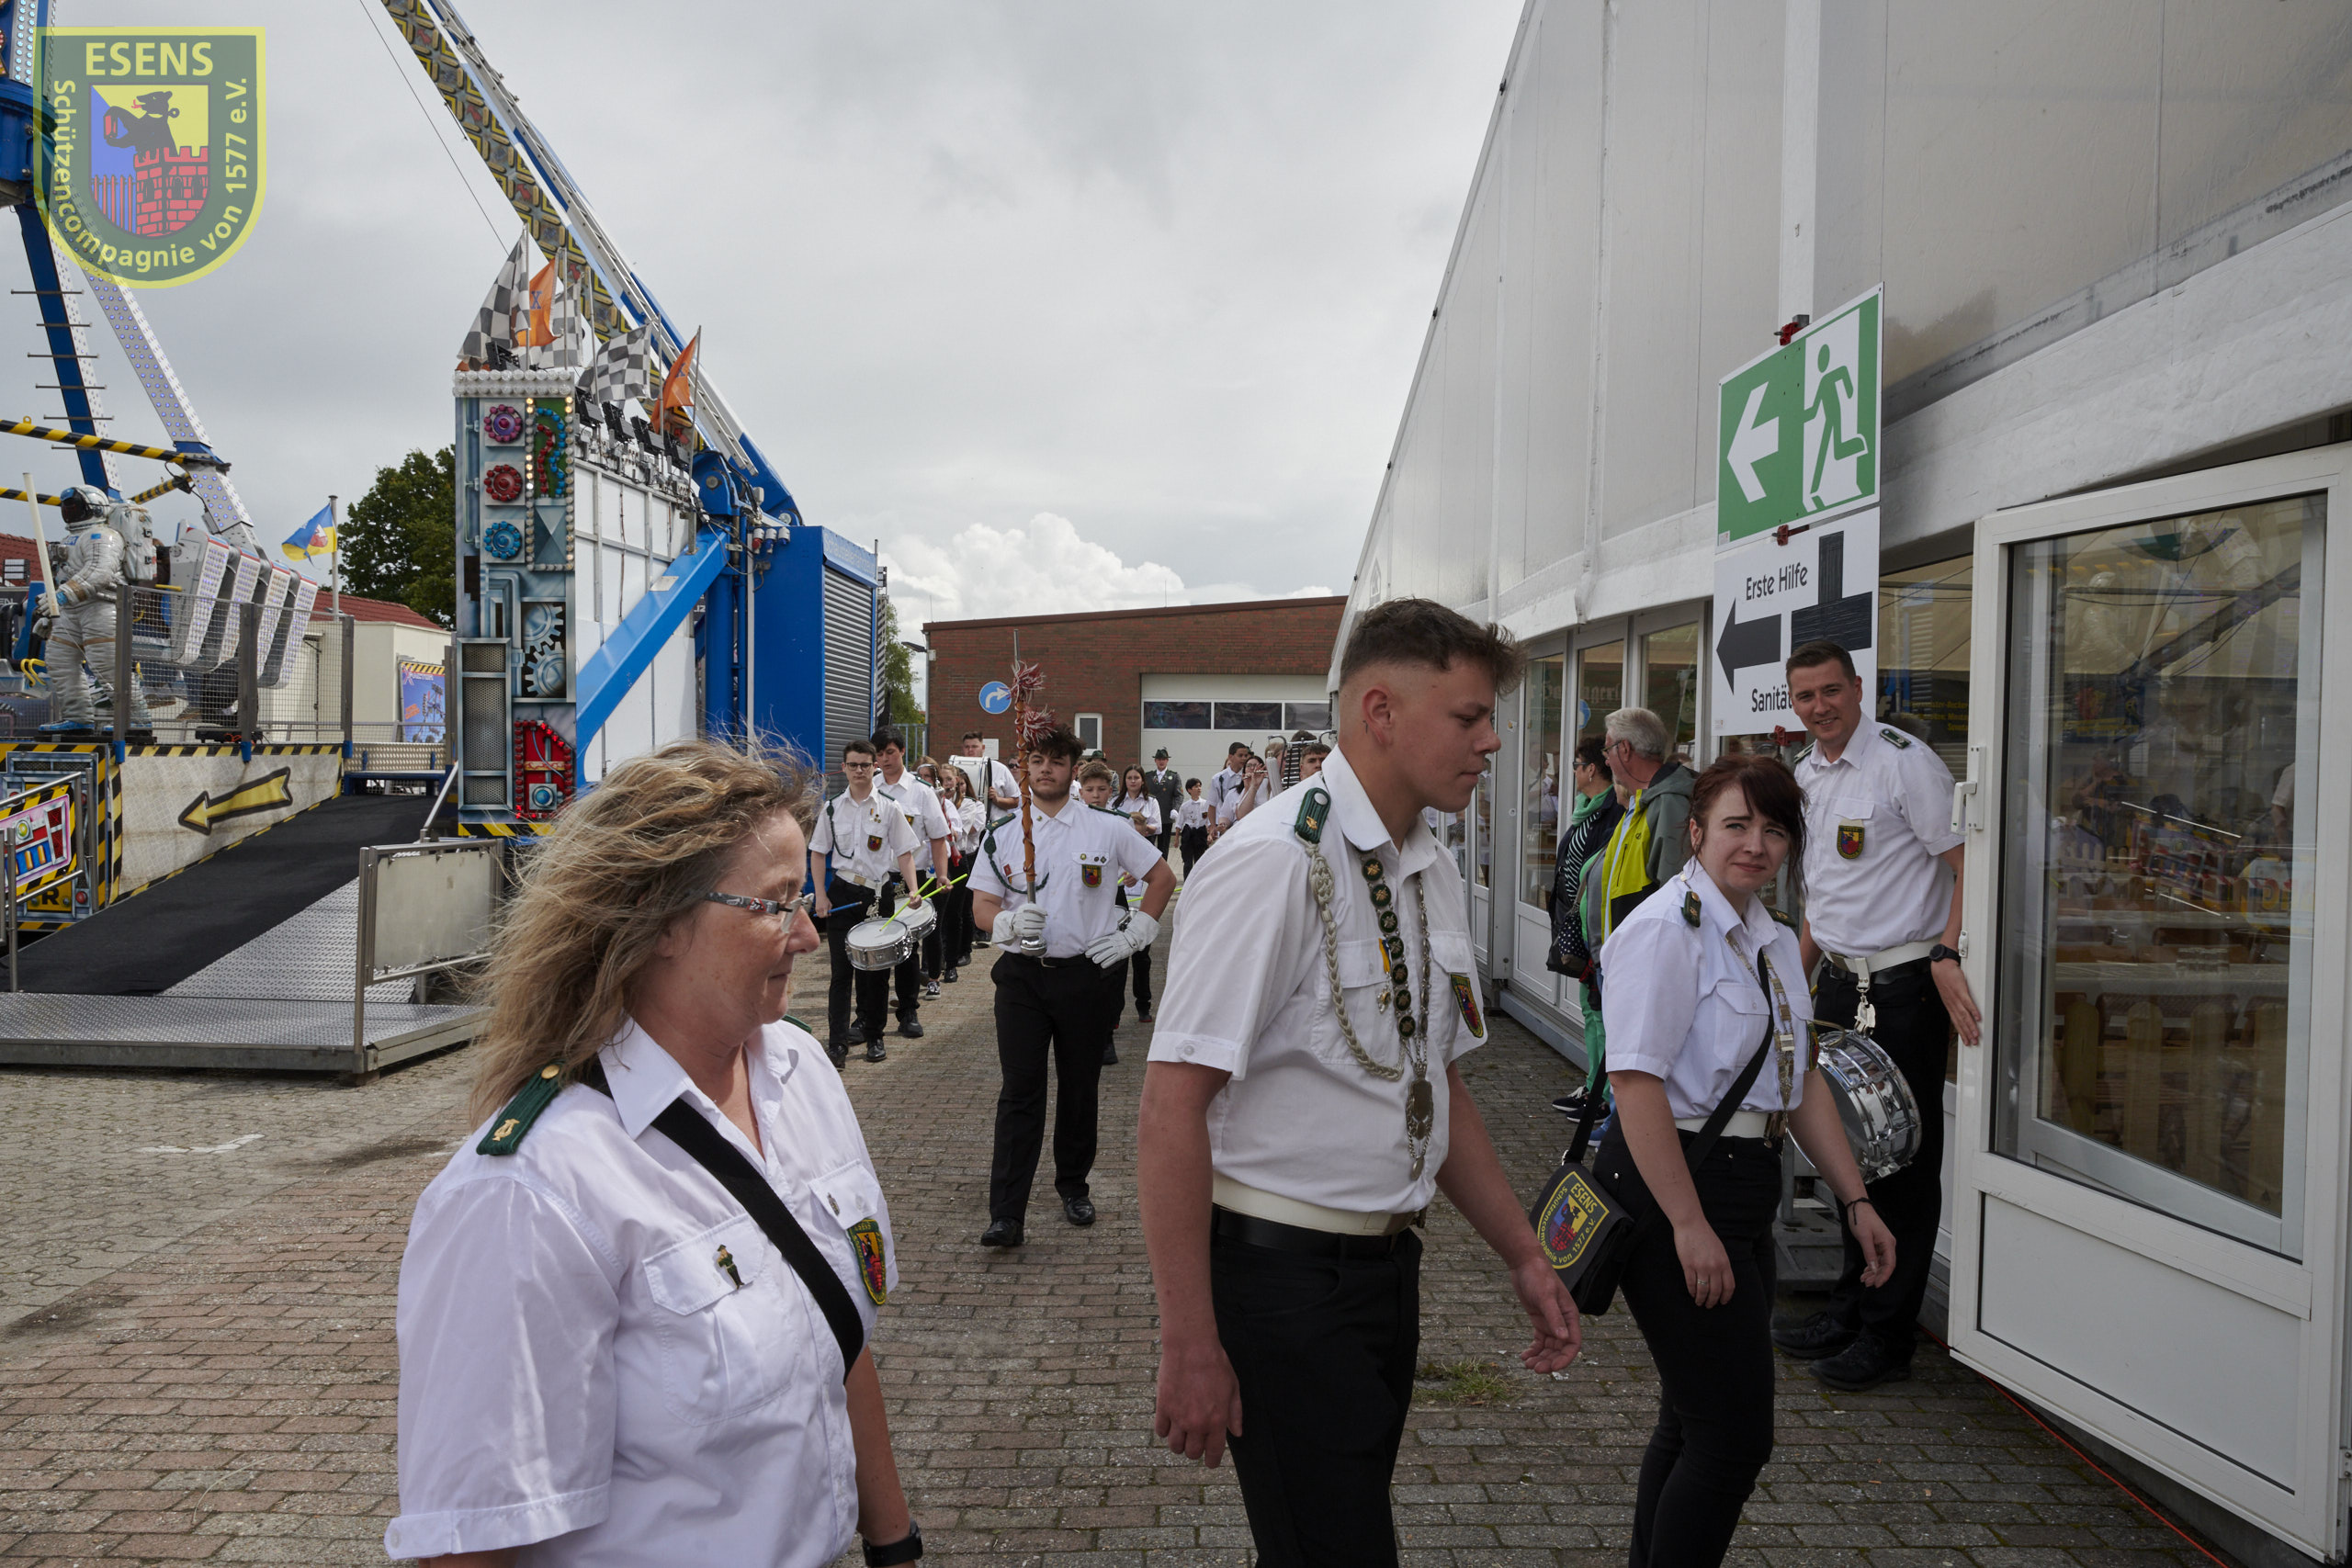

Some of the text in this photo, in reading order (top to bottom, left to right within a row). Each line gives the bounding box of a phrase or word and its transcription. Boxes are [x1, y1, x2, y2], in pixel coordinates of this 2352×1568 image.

[530, 290, 543, 310] X
[1746, 562, 1808, 601] Erste Hilfe
[1570, 1182, 1598, 1213] ESENS
[1558, 1253, 1573, 1264] von
[1572, 1233, 1586, 1253] 1577
